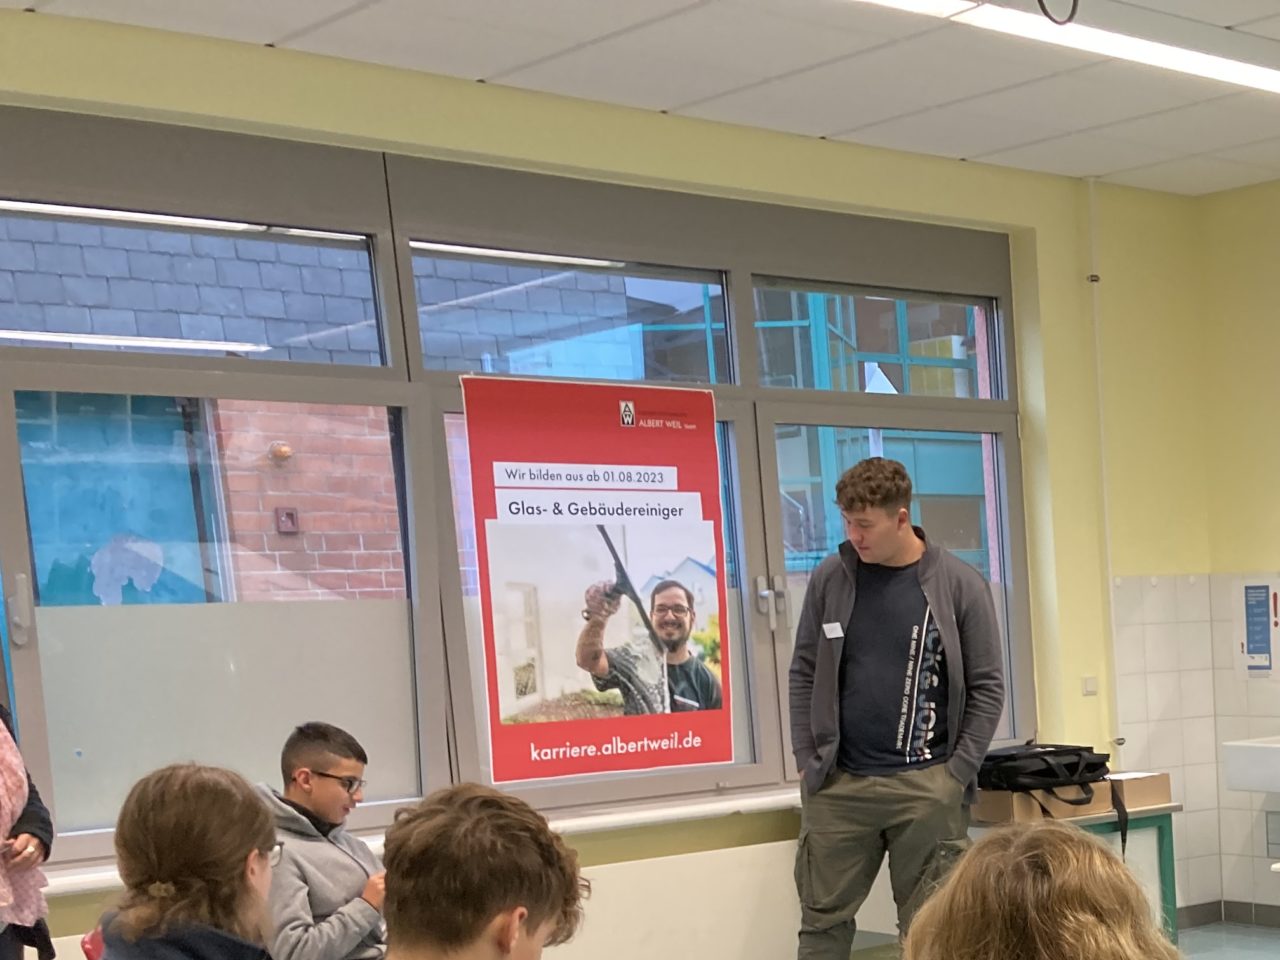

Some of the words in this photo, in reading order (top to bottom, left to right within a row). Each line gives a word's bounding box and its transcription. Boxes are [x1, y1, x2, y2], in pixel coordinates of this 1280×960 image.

[639, 419, 663, 428] ALBERT
[665, 420, 682, 429] WEIL
[504, 468, 526, 481] Wir
[528, 468, 561, 481] bilden
[565, 472, 584, 483] aus
[587, 470, 601, 483] ab
[602, 471, 665, 484] 01.08.2023
[508, 501, 548, 517] Glas-
[552, 502, 564, 516] &
[567, 501, 685, 521] Gebäudereiniger
[530, 730, 702, 762] karriere.albertweil.de
